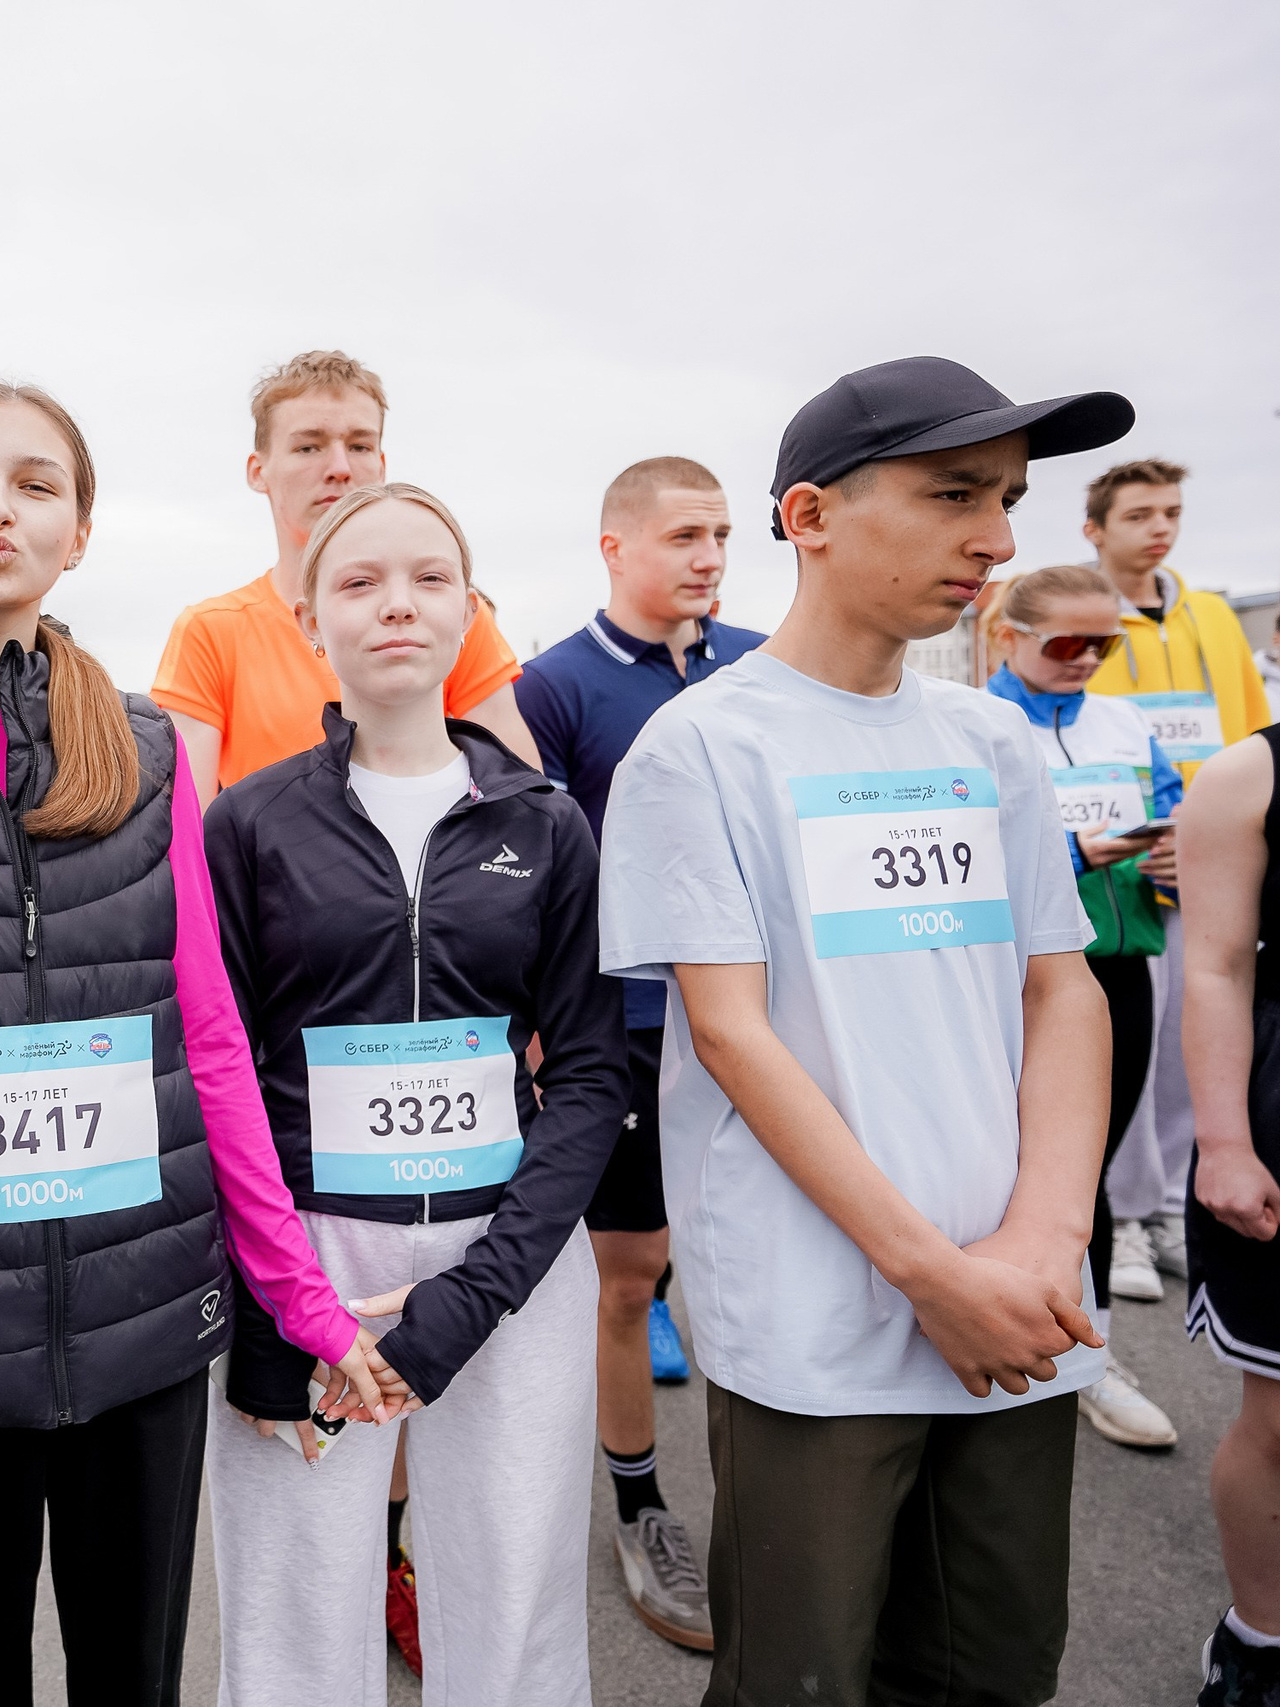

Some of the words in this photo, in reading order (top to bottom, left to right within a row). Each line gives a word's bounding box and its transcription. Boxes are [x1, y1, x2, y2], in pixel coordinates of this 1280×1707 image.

[854, 791, 880, 801] СБЕР
[1061, 801, 1121, 823] 3374
[888, 829, 917, 840] 15-17
[921, 827, 943, 838] ЛЕТ
[479, 862, 533, 878] DEMIX
[871, 842, 972, 890] 3319
[19, 1049, 53, 1059] марафон
[359, 1044, 389, 1053] СБЕР
[390, 1080, 423, 1091] 15-17
[427, 1078, 450, 1089] ЛЕТ
[3, 1090, 38, 1104] 15-17
[43, 1087, 69, 1101] ЛЕТ
[368, 1092, 477, 1137] 3323
